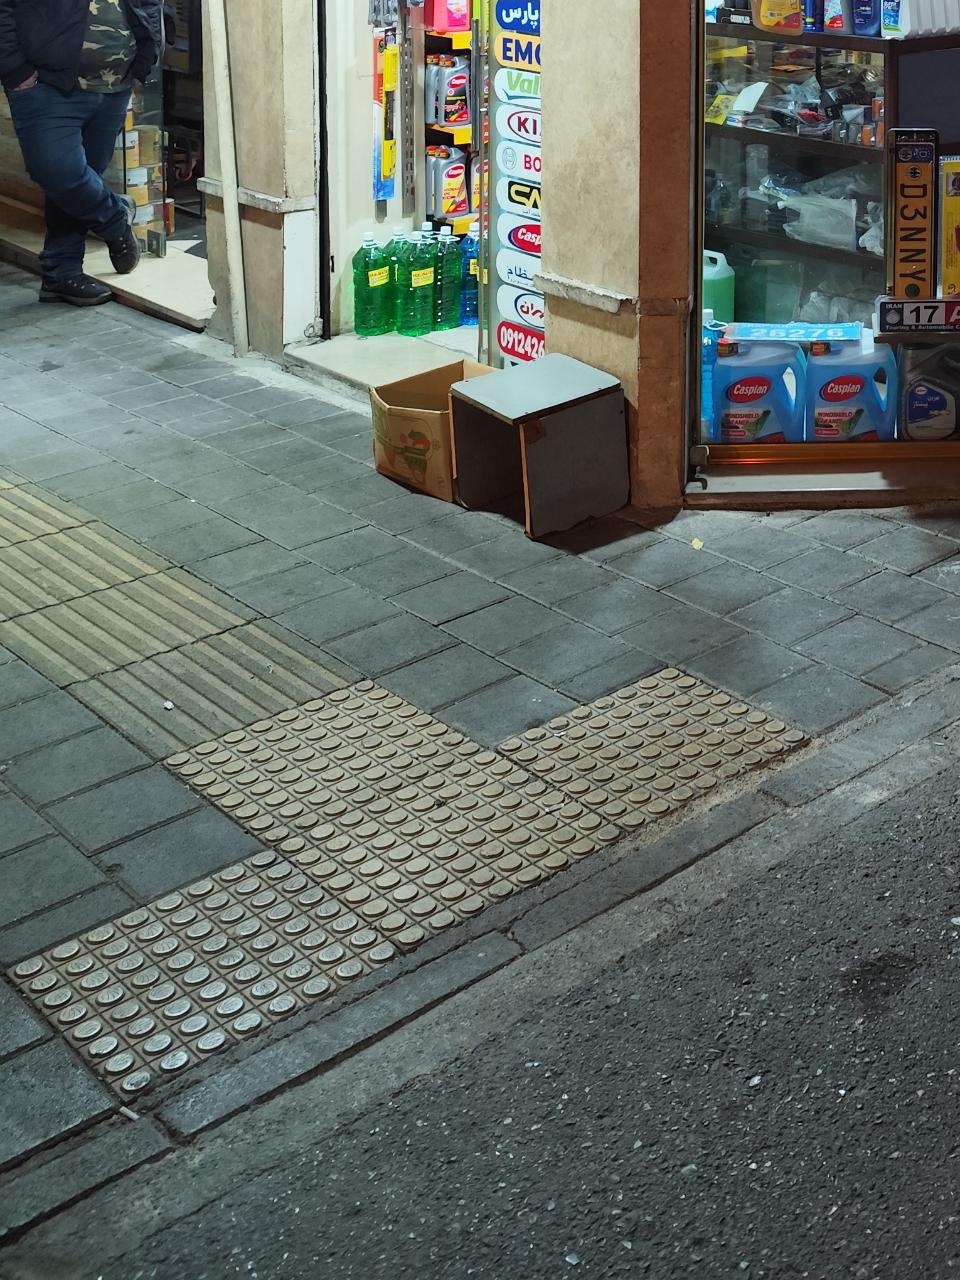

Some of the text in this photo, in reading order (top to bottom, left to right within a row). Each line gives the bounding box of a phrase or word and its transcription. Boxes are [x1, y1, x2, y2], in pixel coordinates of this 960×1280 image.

[502, 2, 539, 29] پارس
[507, 71, 540, 96] Val
[517, 116, 541, 137] KI
[517, 227, 542, 246] Casp
[899, 183, 928, 282] D3NNY
[909, 304, 940, 324] 17
[500, 325, 544, 360] 0912426
[733, 383, 768, 396] Caspian
[827, 382, 861, 396] Caspian
